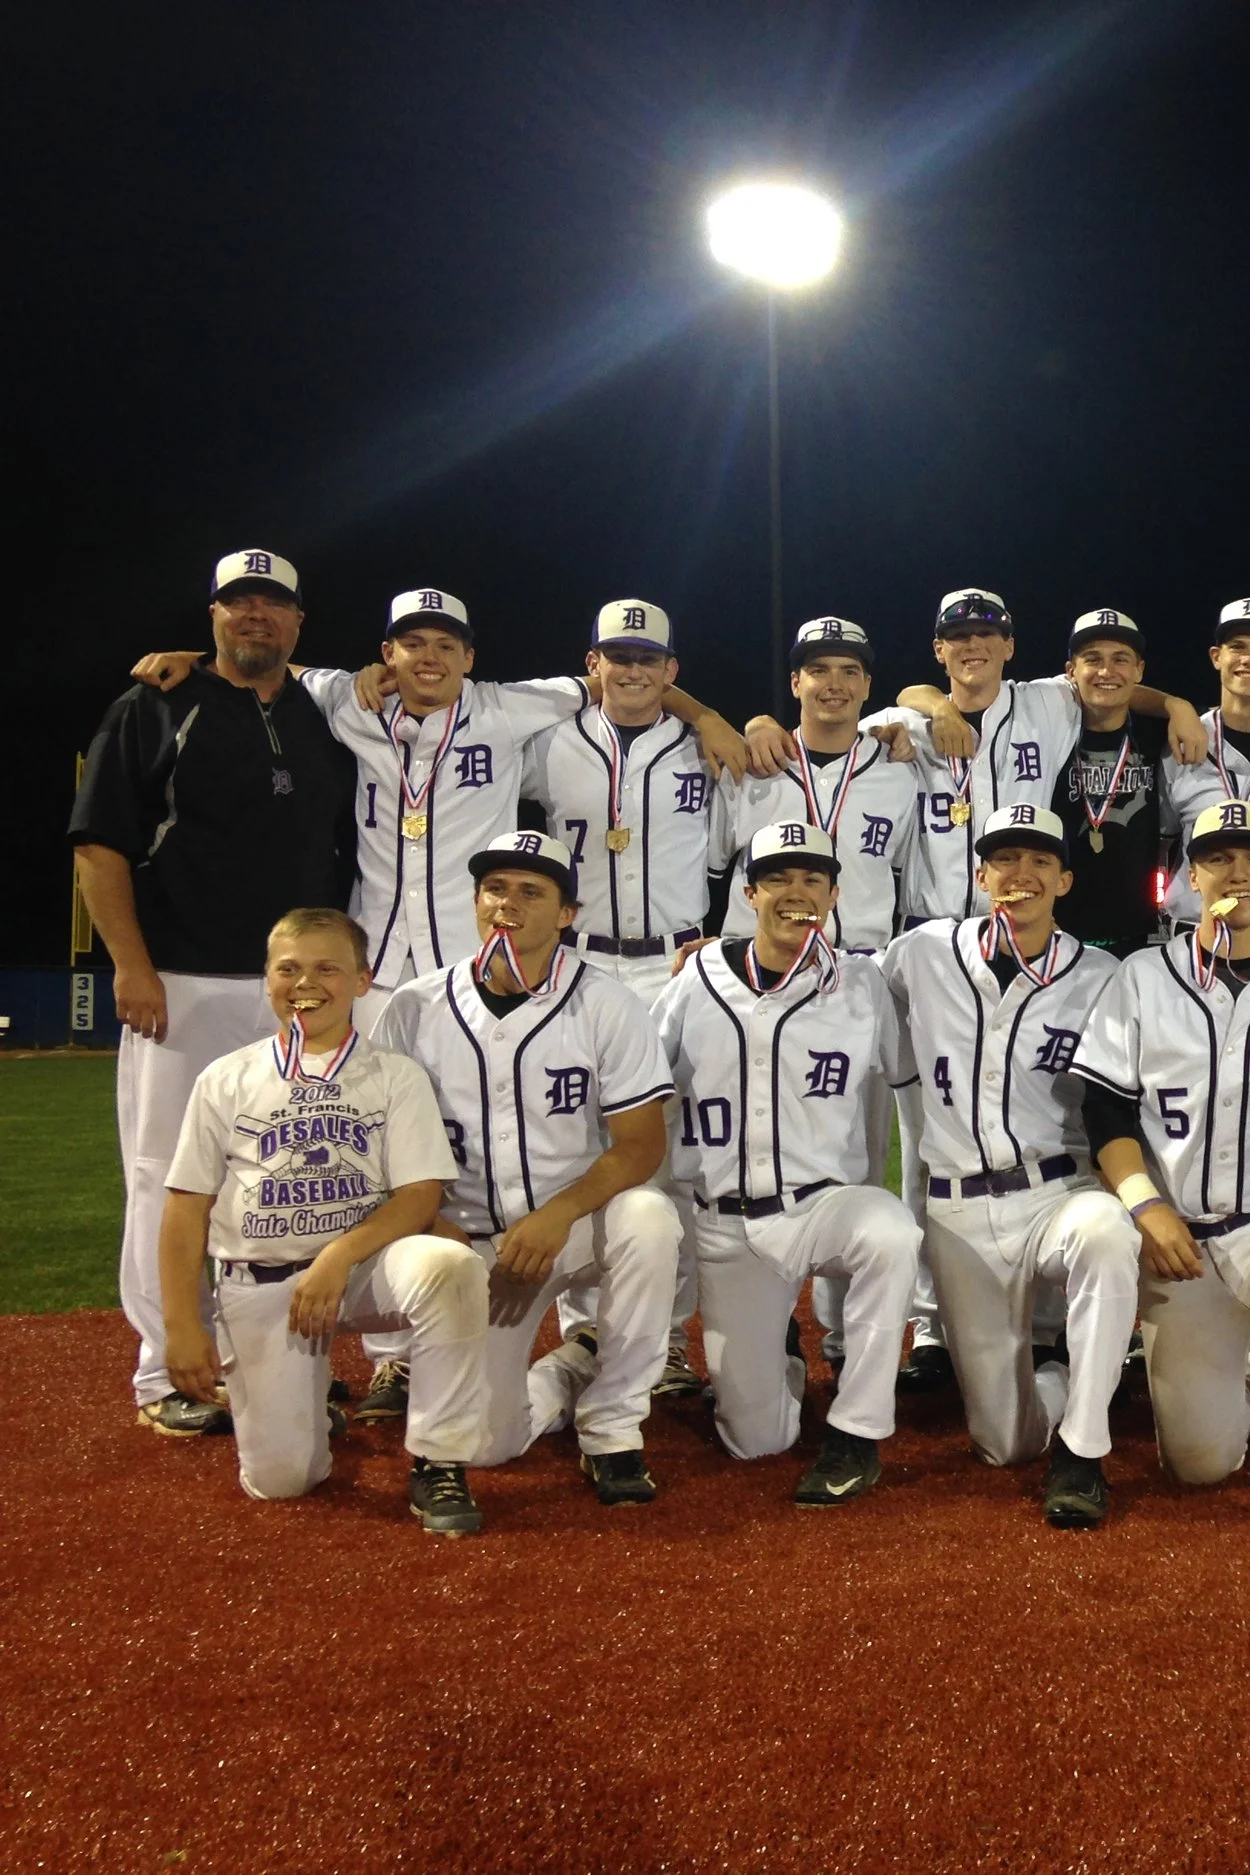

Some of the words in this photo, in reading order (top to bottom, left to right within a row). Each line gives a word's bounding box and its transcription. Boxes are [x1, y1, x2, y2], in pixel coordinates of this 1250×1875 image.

[244, 553, 271, 574] D
[418, 591, 443, 609] D
[622, 607, 645, 630] D
[1097, 611, 1118, 625] D
[821, 620, 842, 640] D
[454, 744, 493, 788] D
[1011, 742, 1042, 782] D
[365, 783, 376, 828] 1
[673, 772, 707, 813] D
[917, 792, 955, 833] 19
[860, 812, 893, 857] D
[1010, 804, 1035, 825] D
[1221, 804, 1247, 830] D
[514, 833, 542, 854] D
[565, 819, 587, 863] 7
[779, 824, 806, 847] D
[77, 977, 90, 1027] 325
[1031, 1023, 1081, 1074] D
[290, 1085, 341, 1104] 2012
[544, 1066, 589, 1118] D
[802, 1050, 850, 1099] D
[933, 1057, 953, 1106] 4
[270, 1110, 293, 1121] St.
[298, 1103, 360, 1116] Francis
[681, 1097, 731, 1147] 10
[1157, 1088, 1189, 1140] 5
[257, 1115, 371, 1163] DESALES
[258, 1174, 372, 1209] BASEBALL
[242, 1212, 289, 1239] State
